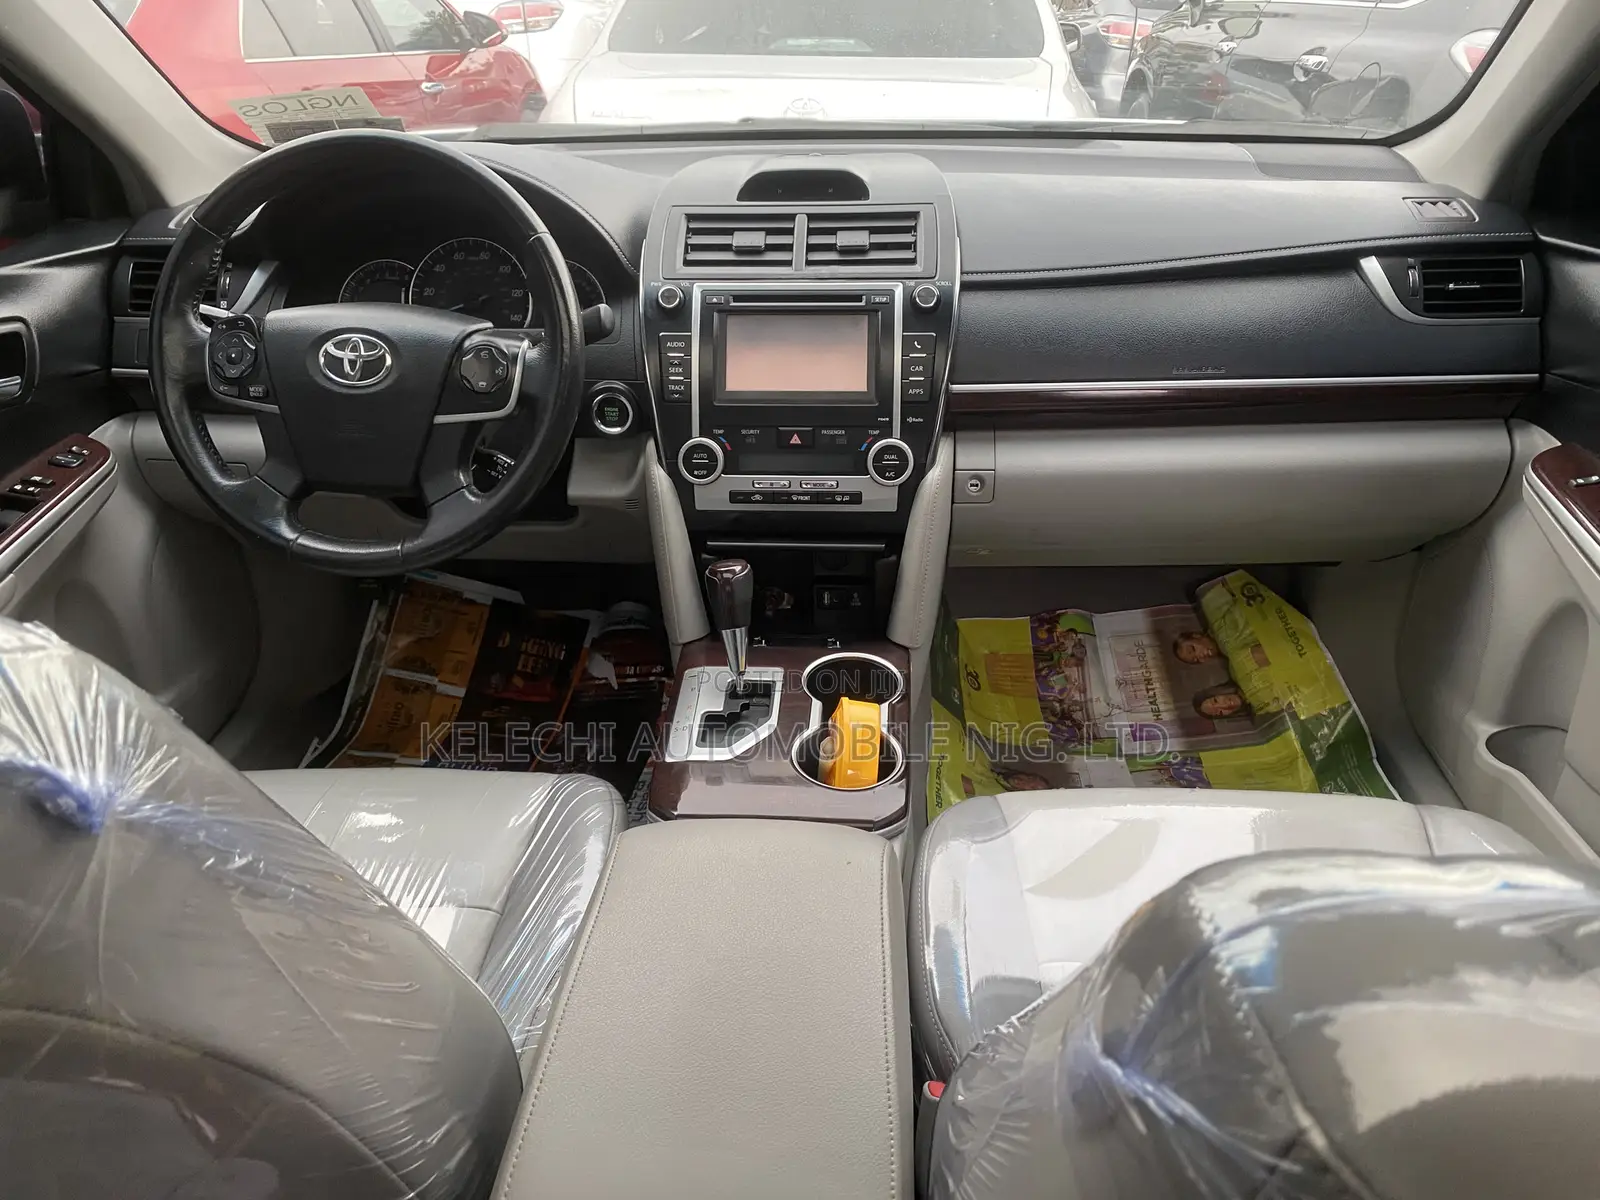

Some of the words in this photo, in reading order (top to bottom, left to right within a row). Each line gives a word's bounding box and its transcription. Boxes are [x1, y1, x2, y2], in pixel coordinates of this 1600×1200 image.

[453, 252, 465, 260] 60
[480, 252, 491, 260] 80
[433, 264, 446, 272] 40
[499, 265, 511, 273] 100
[423, 287, 435, 296] 20
[511, 289, 524, 297] 120
[1275, 607, 1307, 659] TOGETHER
[1134, 639, 1163, 721] HEALTHGARDE
